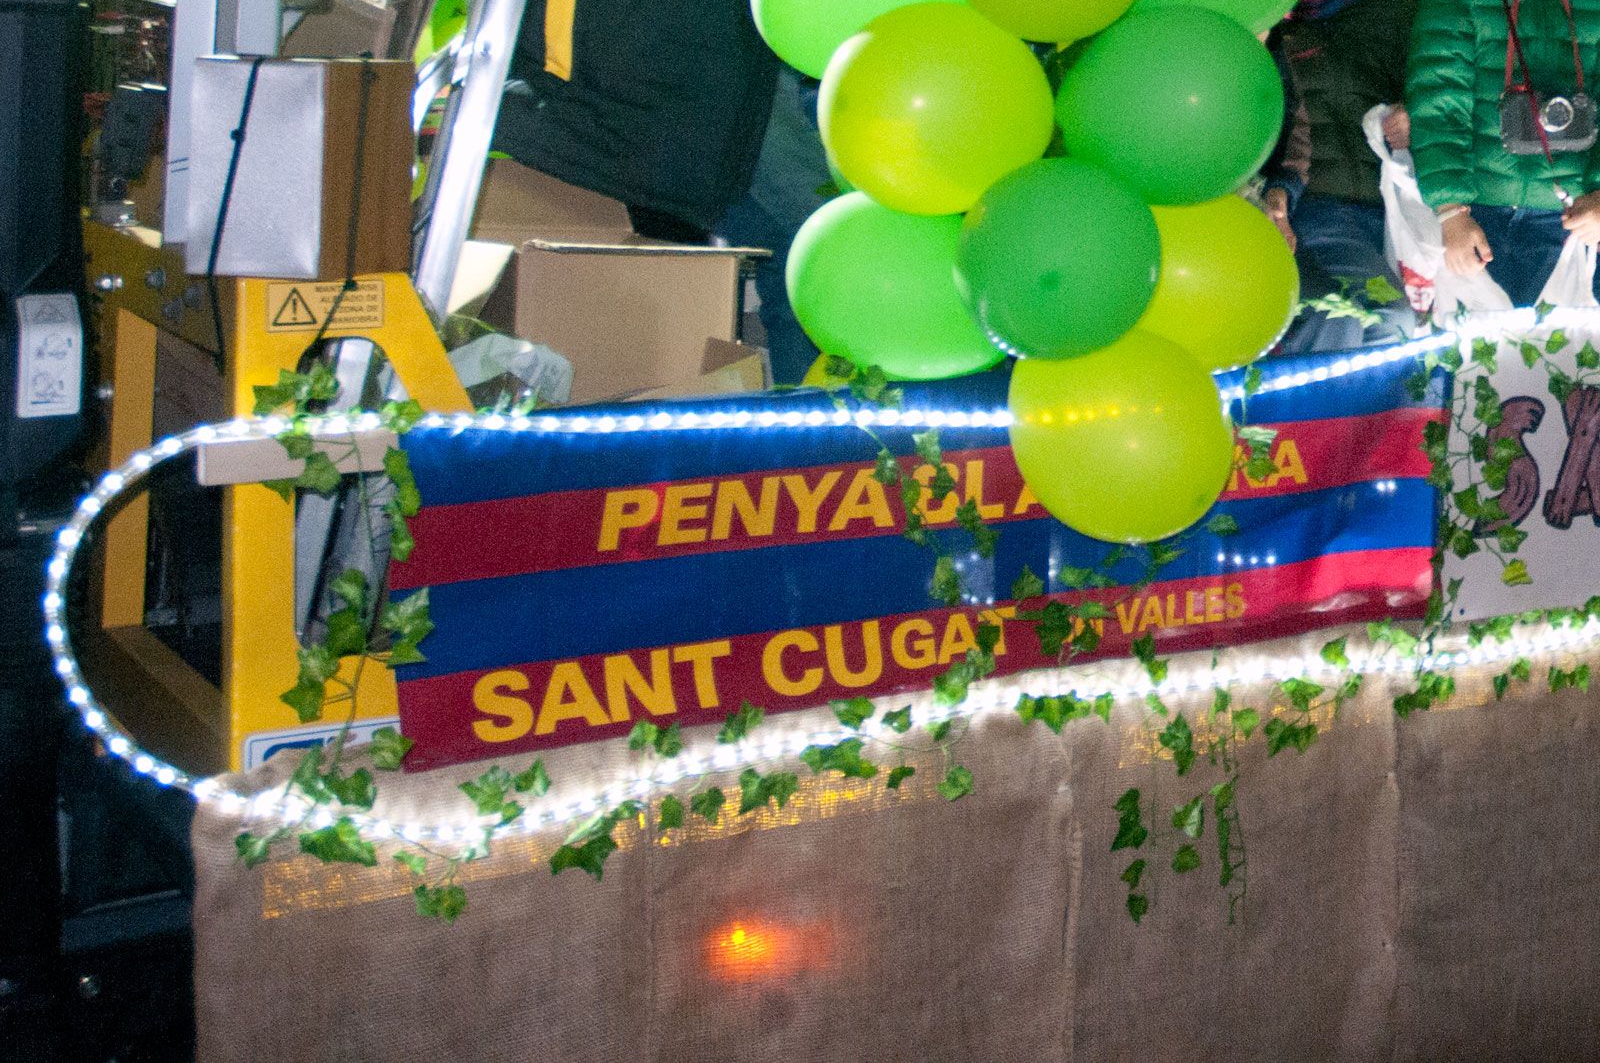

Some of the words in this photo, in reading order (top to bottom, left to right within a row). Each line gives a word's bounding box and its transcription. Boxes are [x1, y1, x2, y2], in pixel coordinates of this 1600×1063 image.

[597, 467, 896, 552] PENYA
[471, 639, 732, 744] SANT
[761, 606, 1018, 697] CUGAT
[1115, 582, 1248, 635] VALLES
